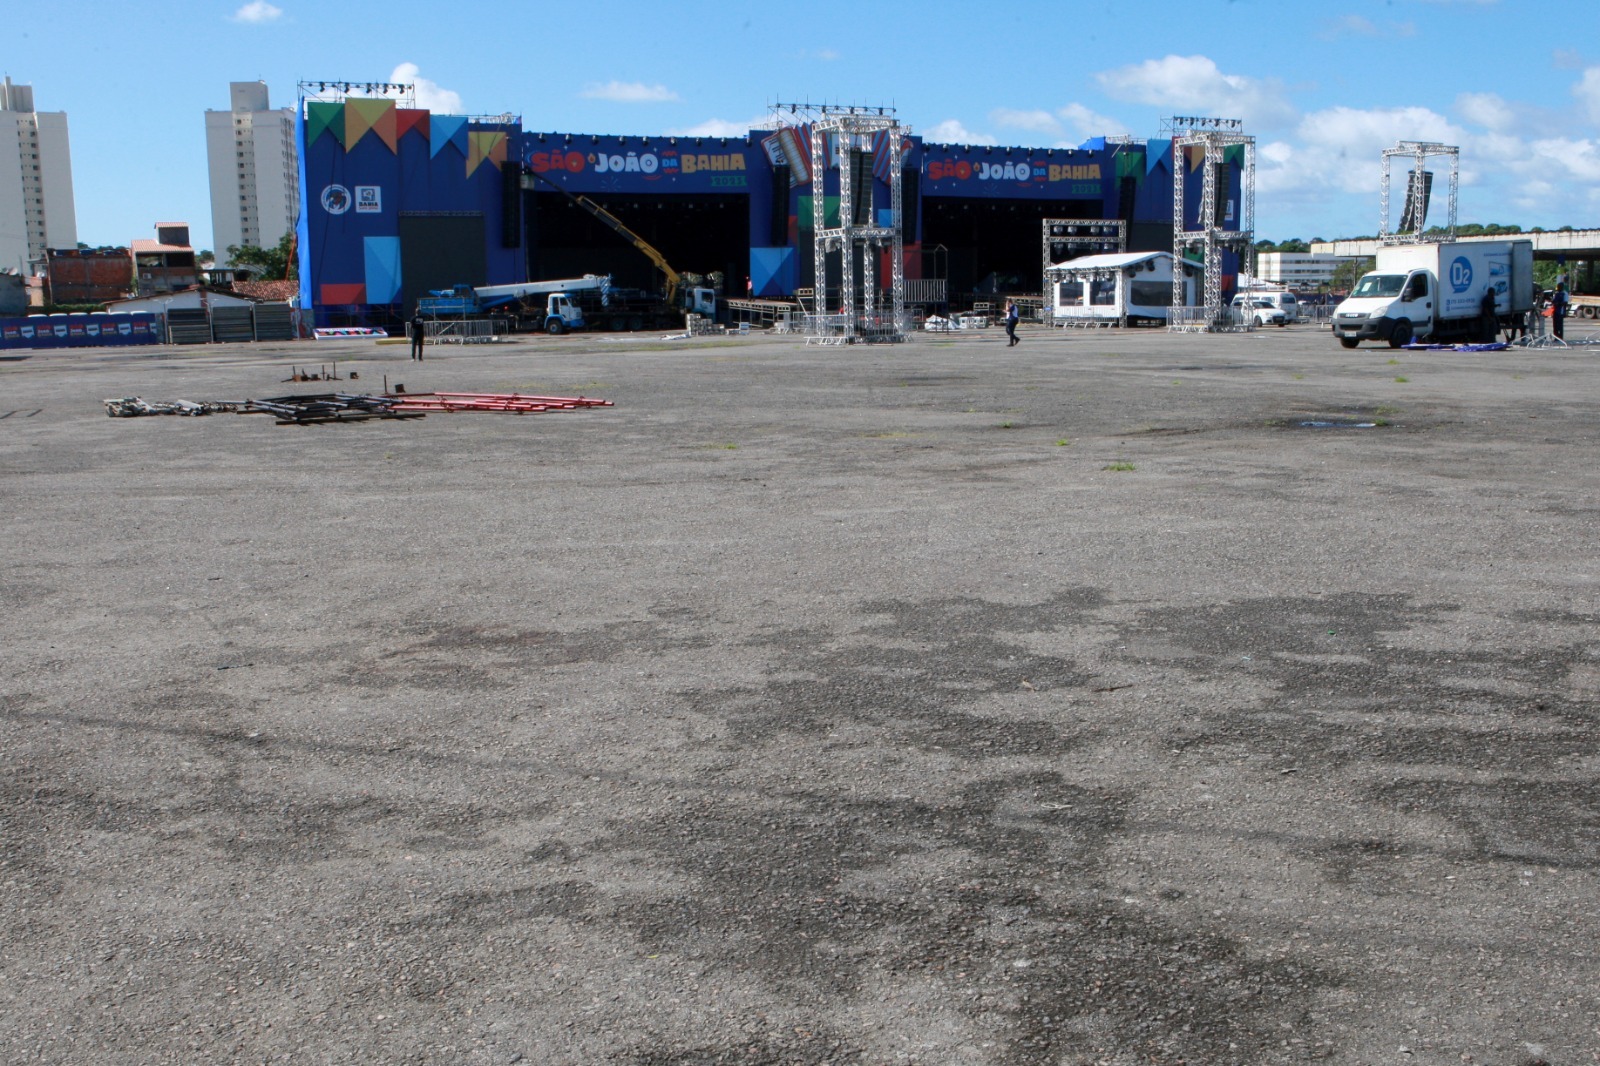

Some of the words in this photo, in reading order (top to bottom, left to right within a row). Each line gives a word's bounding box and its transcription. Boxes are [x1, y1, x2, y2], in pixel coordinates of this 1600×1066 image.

[531, 150, 585, 172] SÃO
[595, 152, 659, 173] JOÃO
[661, 158, 678, 168] DA
[681, 154, 746, 173] BAHIA
[928, 159, 971, 180] SÃO
[978, 161, 1031, 181] JOÃO
[1033, 167, 1046, 176] DA
[1048, 164, 1102, 182] BAHIA
[1452, 262, 1471, 285] D2
